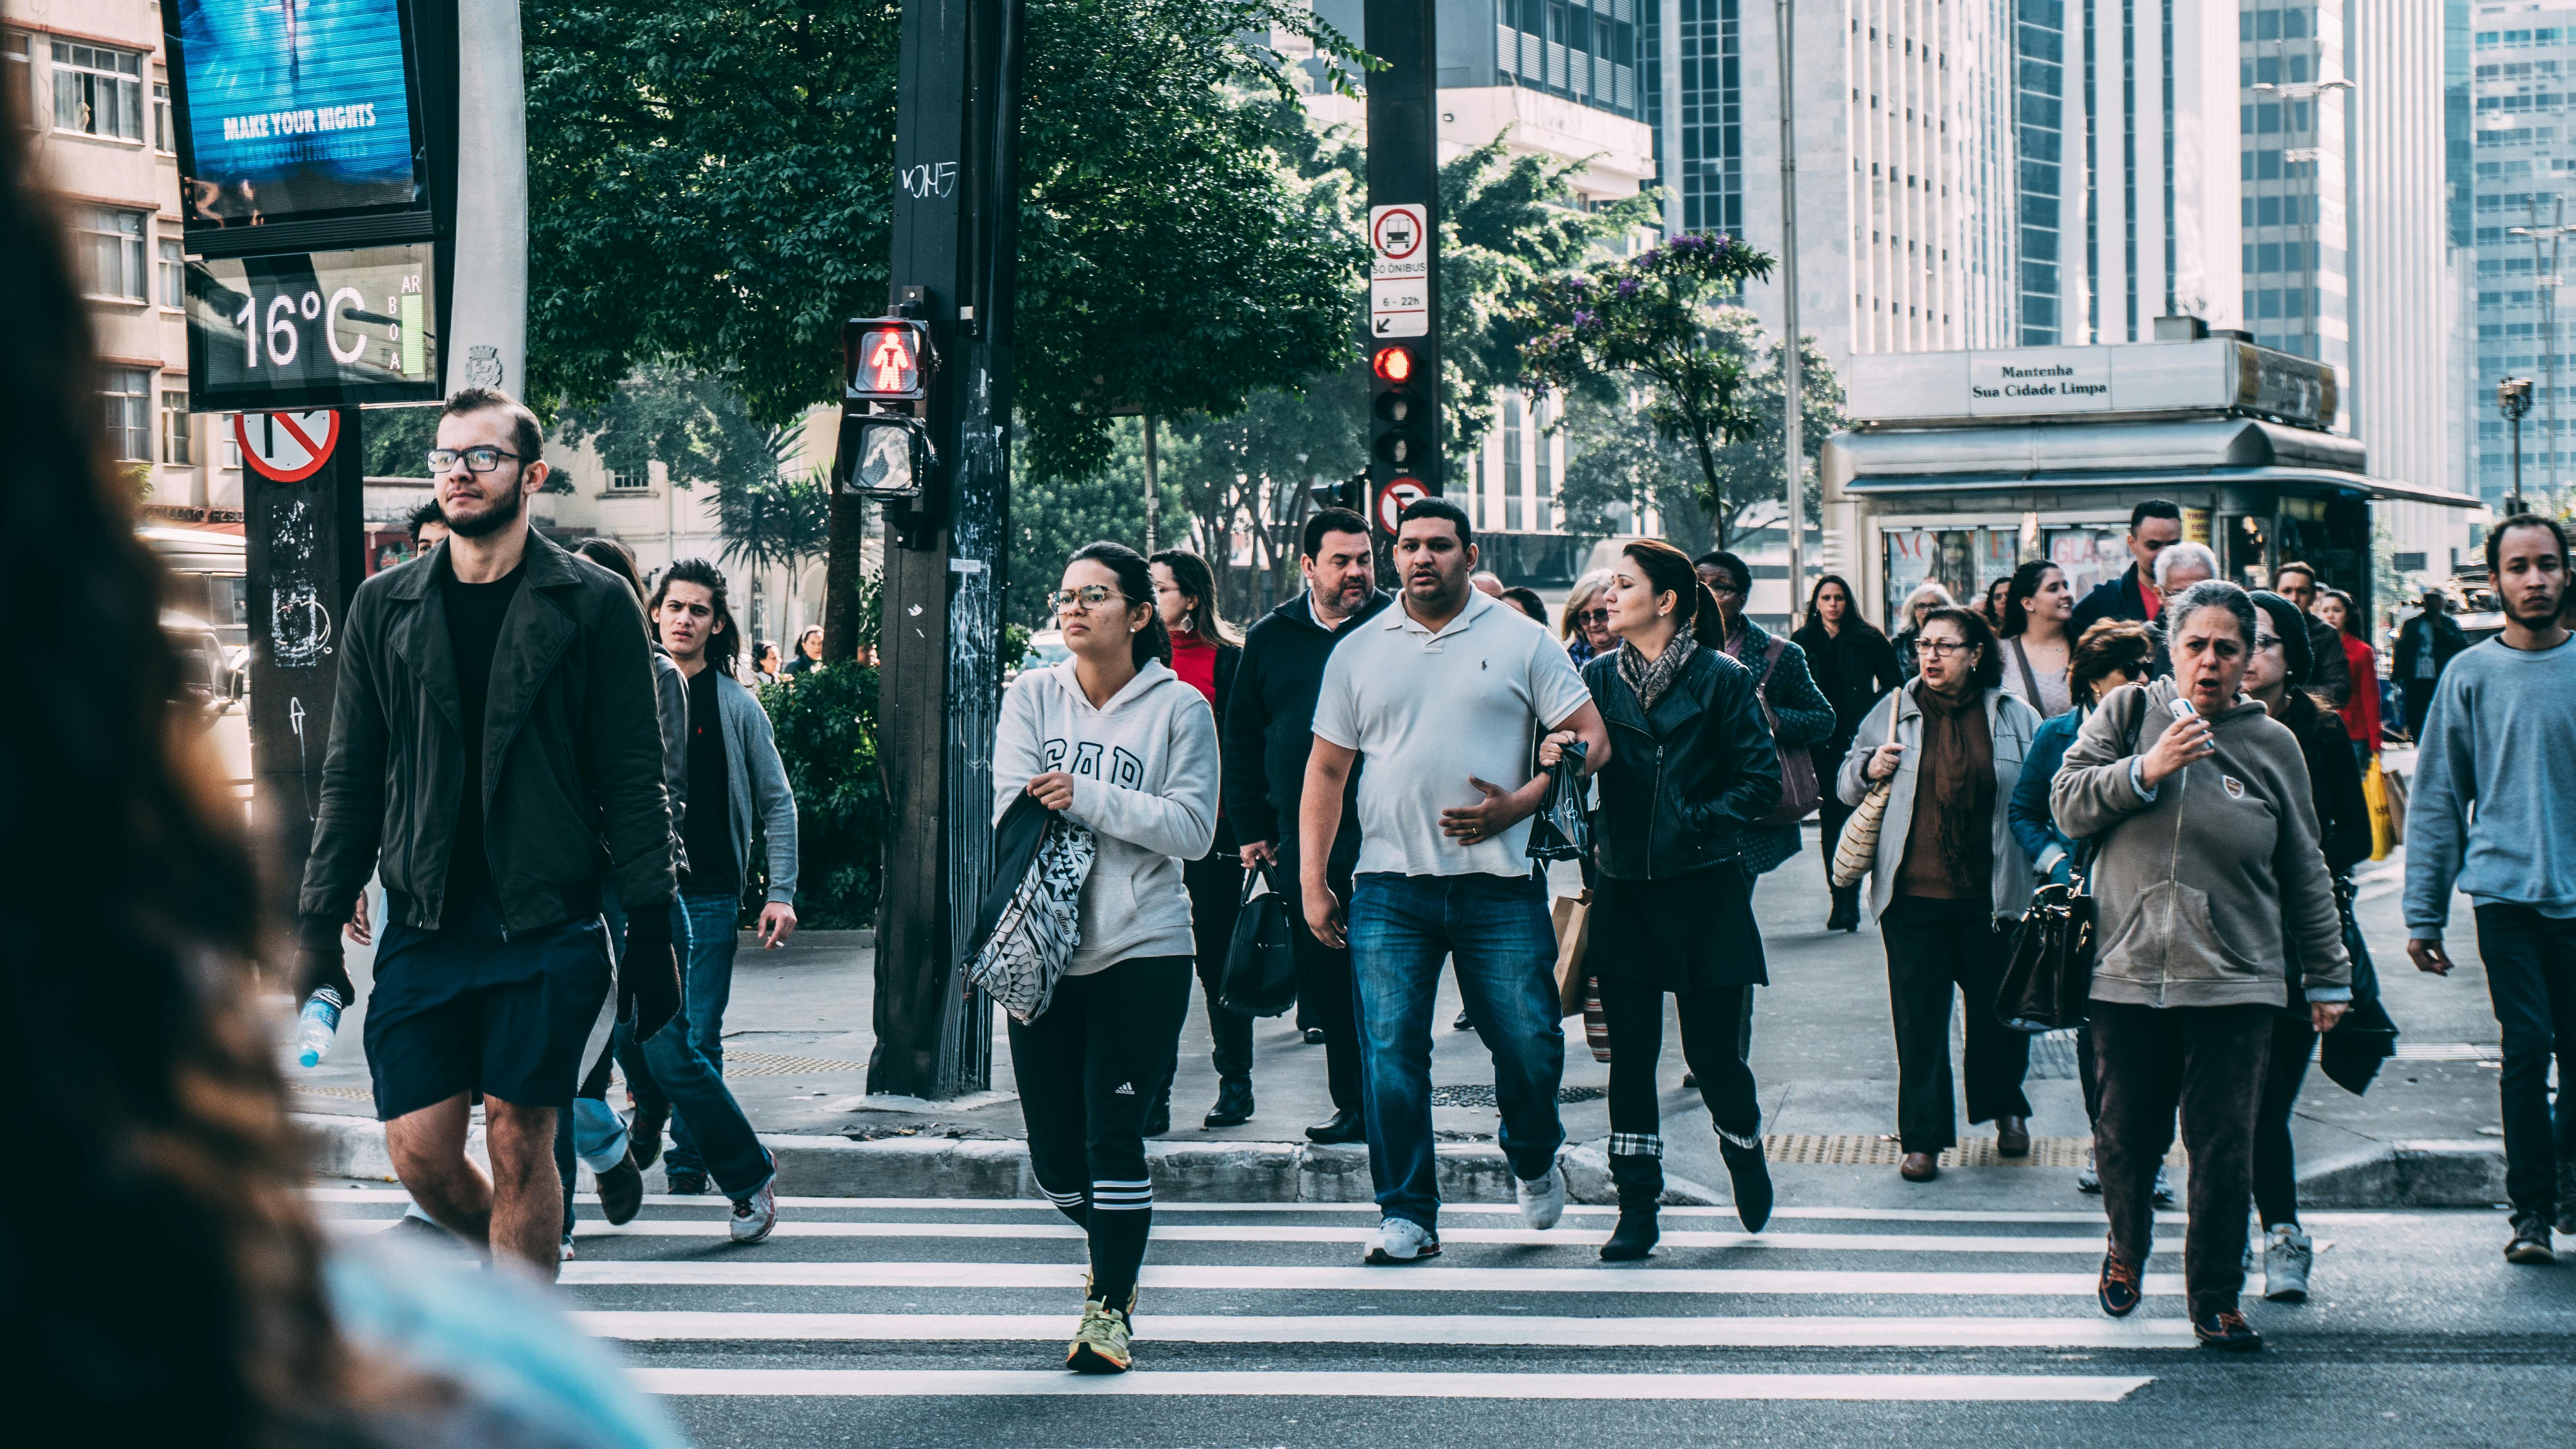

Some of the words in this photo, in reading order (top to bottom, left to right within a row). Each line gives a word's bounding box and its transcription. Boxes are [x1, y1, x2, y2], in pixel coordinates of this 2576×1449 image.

[223, 114, 270, 140] MAKE
[270, 109, 316, 135] YOUR
[317, 103, 376, 131] NIGHTS
[401, 275, 421, 293] AR
[1383, 298, 1389, 306] 6
[1401, 297, 1419, 306] 22h
[2002, 365, 2074, 378] Mantenha
[1973, 385, 2000, 398] Sua
[2005, 383, 2057, 397] Cidade
[2061, 383, 2107, 396] Limpa
